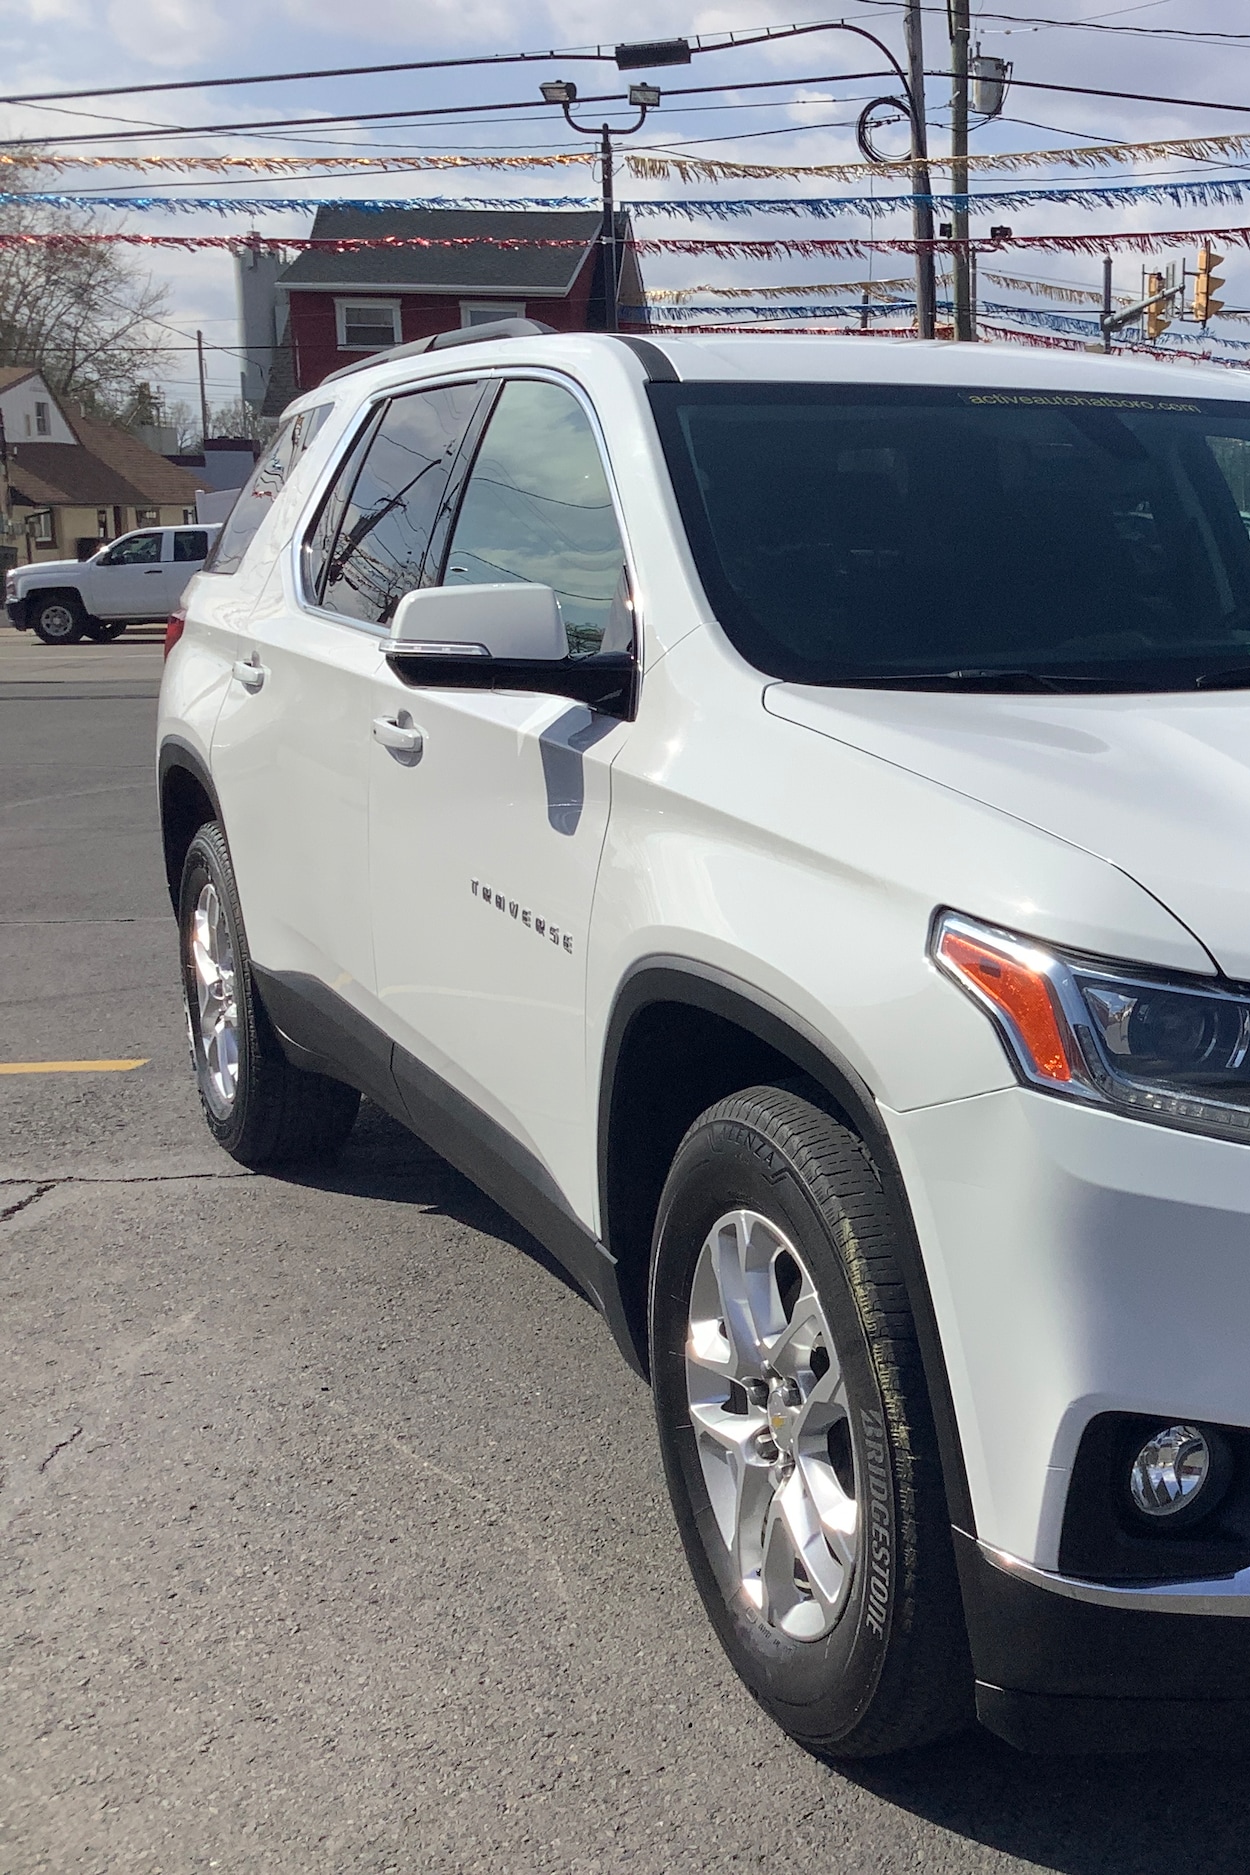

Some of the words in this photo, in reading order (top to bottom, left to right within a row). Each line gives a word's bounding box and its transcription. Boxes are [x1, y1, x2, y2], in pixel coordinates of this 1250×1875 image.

[969, 393, 1202, 413] activeautohatboro.com
[470, 878, 574, 955] TRAVERSE
[860, 1398, 891, 1641] BRIDGESTONE
